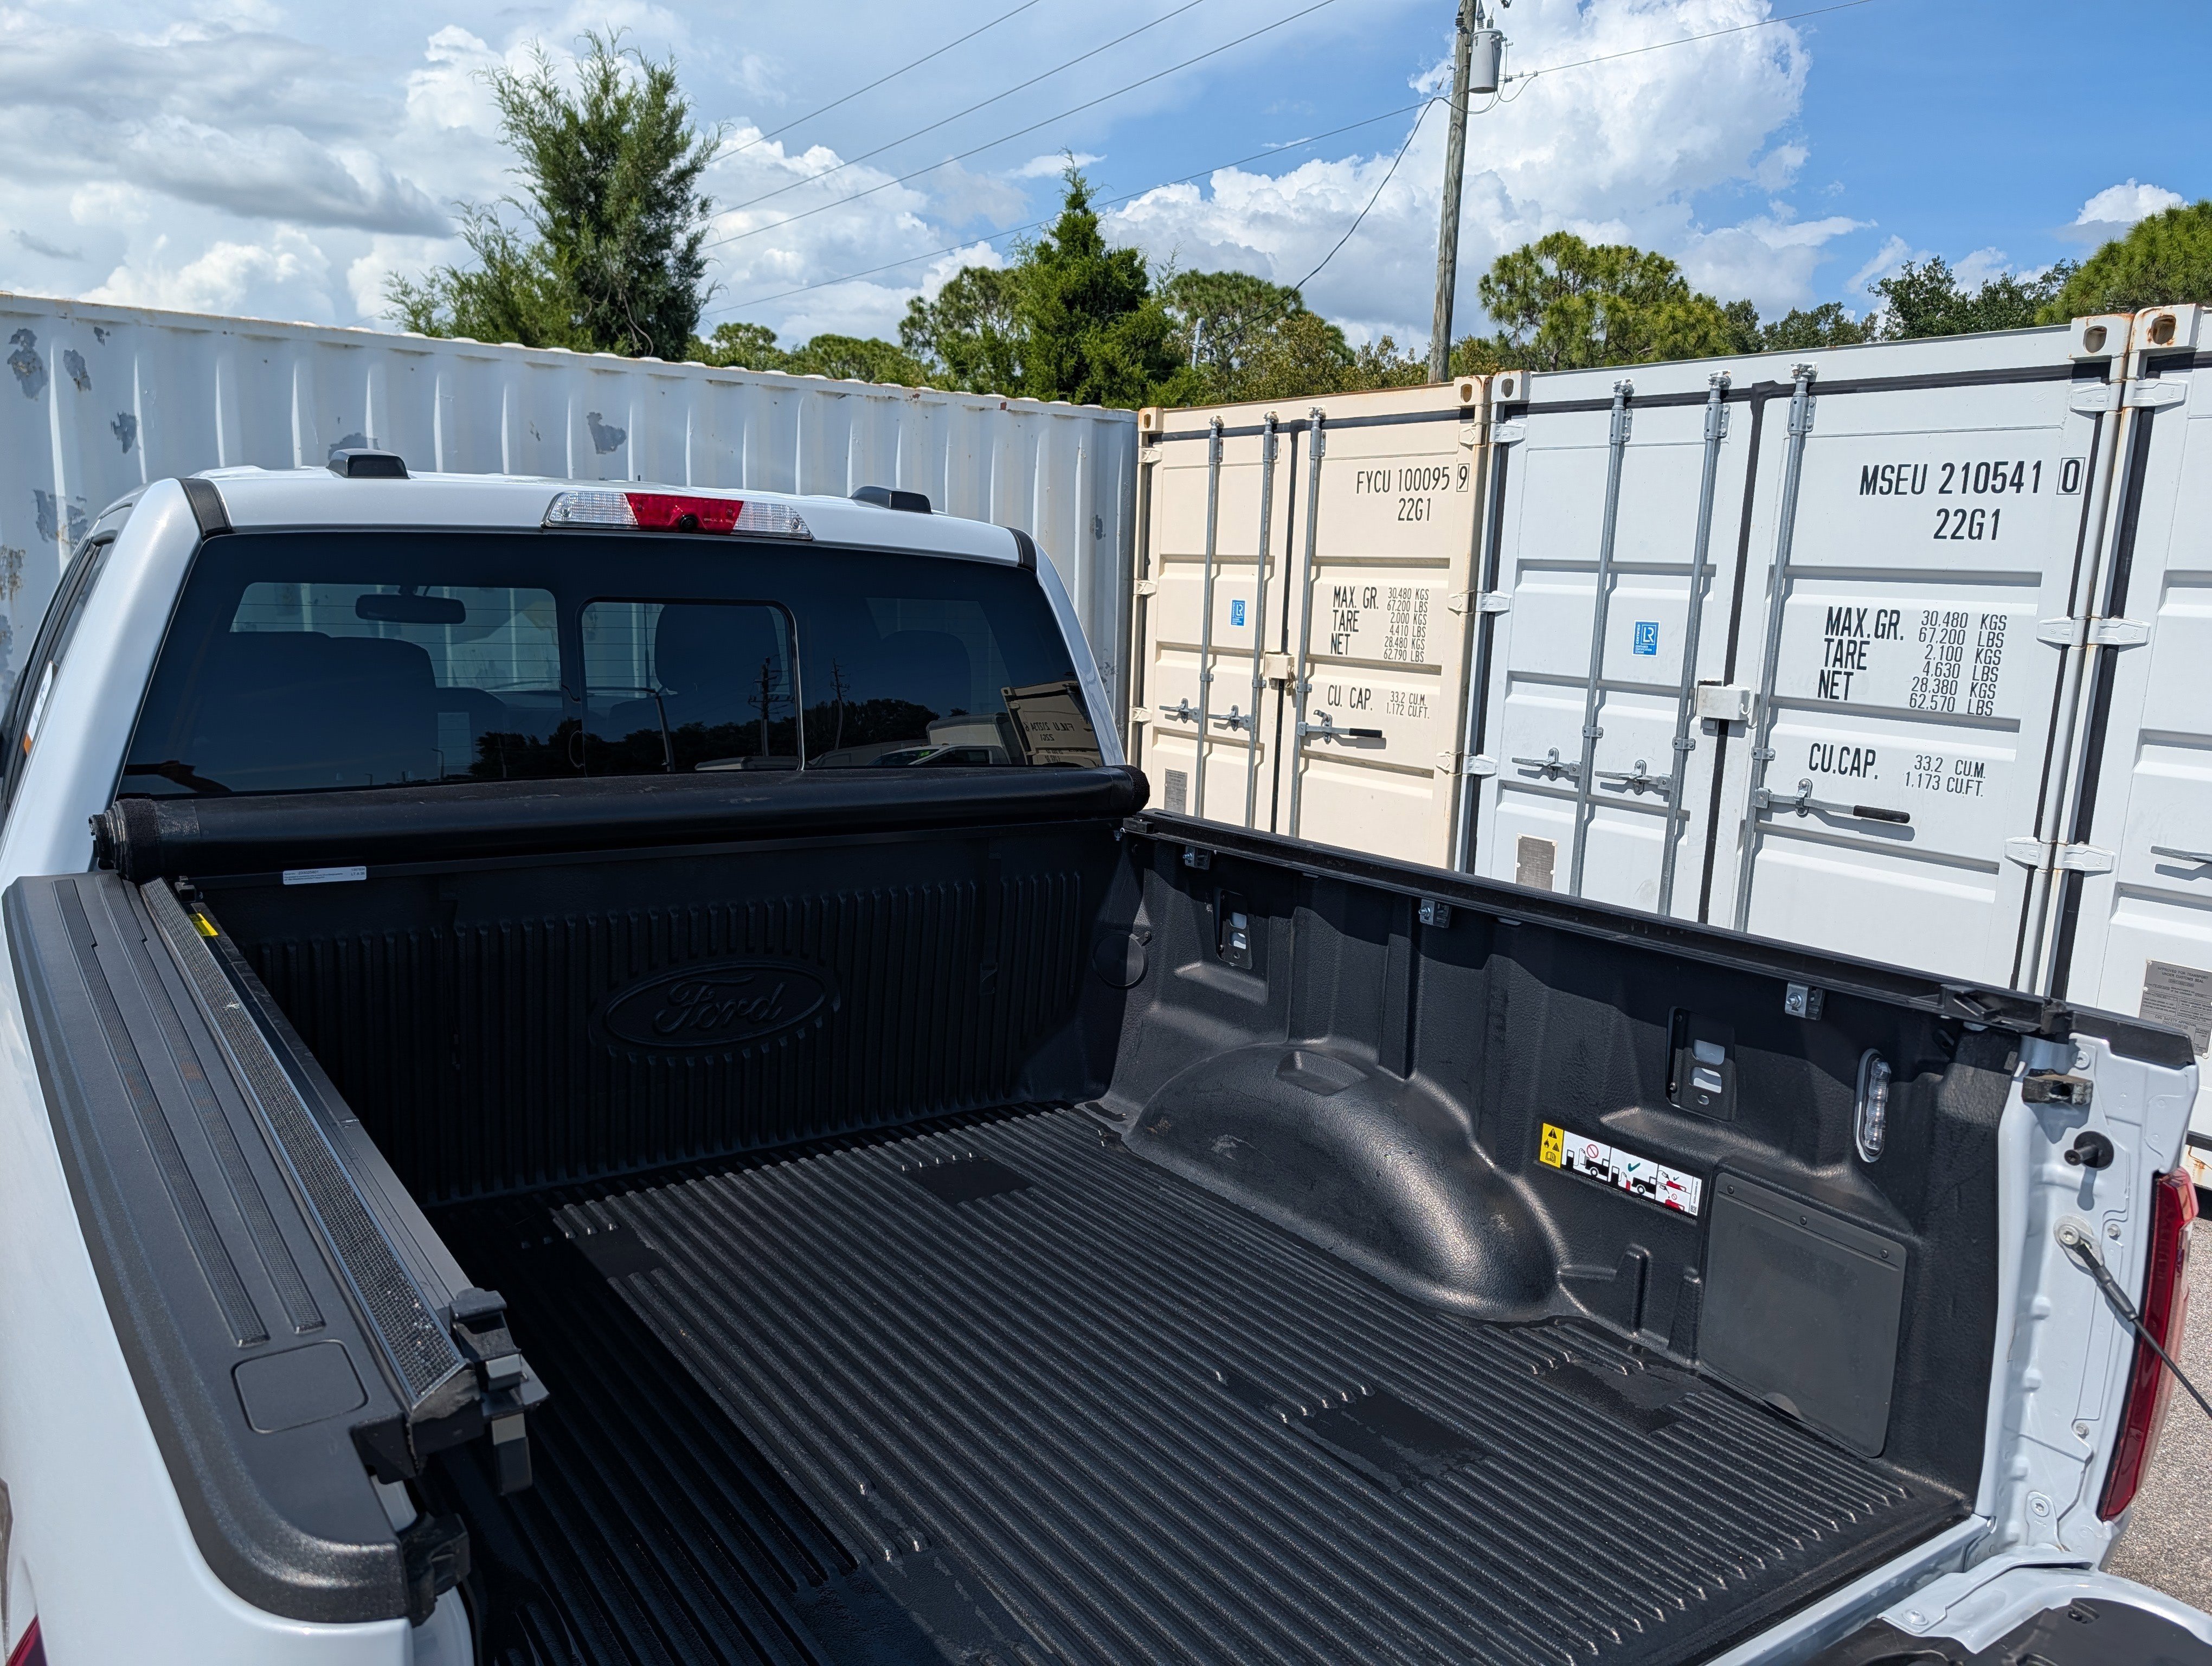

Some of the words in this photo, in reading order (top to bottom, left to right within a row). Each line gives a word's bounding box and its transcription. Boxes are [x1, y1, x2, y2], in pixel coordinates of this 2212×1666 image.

[1356, 470, 1391, 494] FYCU
[1399, 466, 1450, 492] 100095
[1458, 465, 1469, 490] 9
[1859, 463, 1928, 496] MSEU
[1938, 460, 2042, 495] 210541
[2059, 458, 2083, 494] 0
[1398, 497, 1431, 521] 22G1
[1933, 508, 2001, 540] 22G1
[1333, 586, 1356, 608] MAX.
[1363, 587, 1379, 610] GR.
[1415, 588, 1429, 600] KGS
[1414, 601, 1428, 613] LBS
[1333, 610, 1360, 632] TARE
[1413, 613, 1427, 625] KGS
[1412, 626, 1426, 638] LBS
[1980, 613, 2008, 631] KGS
[1330, 633, 1351, 655] NET
[1411, 638, 1425, 650] KGS
[1643, 627, 1654, 643] LR
[1977, 631, 2004, 648] LBS
[1411, 650, 1424, 662] LBS
[1824, 638, 1870, 670] TARE
[1975, 648, 2002, 665] KGS
[1817, 669, 1854, 701] NET
[1970, 682, 1997, 699] KGS
[1972, 665, 1999, 683] LBS
[1328, 684, 1342, 707] CU.
[1349, 687, 1373, 711] CAP.
[1390, 691, 1405, 704] 33.2
[1409, 693, 1426, 706] CU.M.
[1967, 699, 1994, 716] LBS
[1914, 754, 1943, 773] 33.2
[1954, 760, 1986, 779] CU.M.
[1946, 777, 1983, 797] CU.FT.
[653, 973, 787, 1035] Ford
